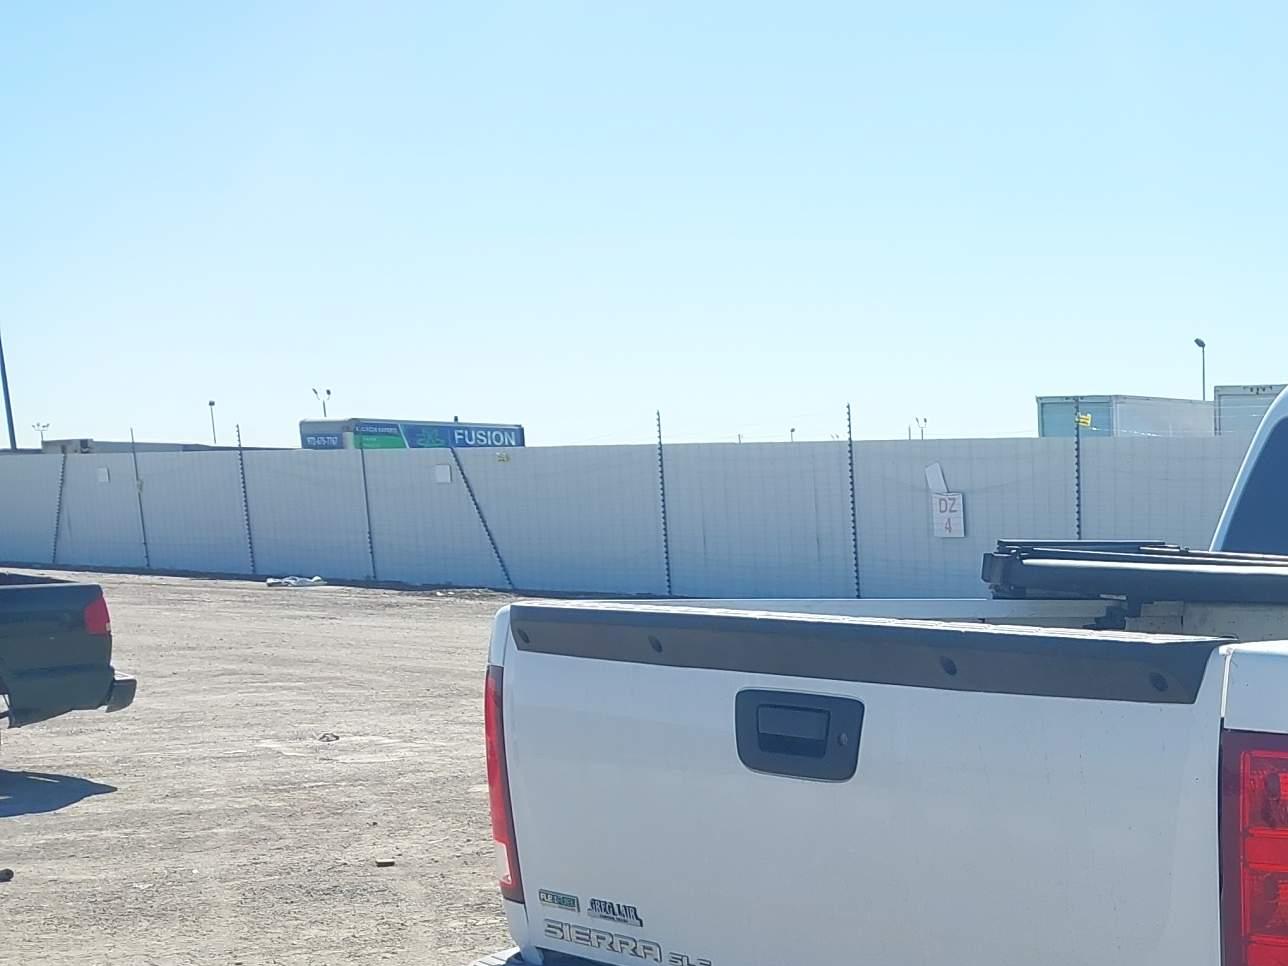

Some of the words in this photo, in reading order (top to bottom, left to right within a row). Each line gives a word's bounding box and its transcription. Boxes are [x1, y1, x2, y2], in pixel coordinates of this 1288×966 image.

[454, 429, 516, 446] FUSION
[938, 497, 958, 513] DZ
[944, 518, 953, 533] 4
[543, 918, 662, 962] SIERRA
